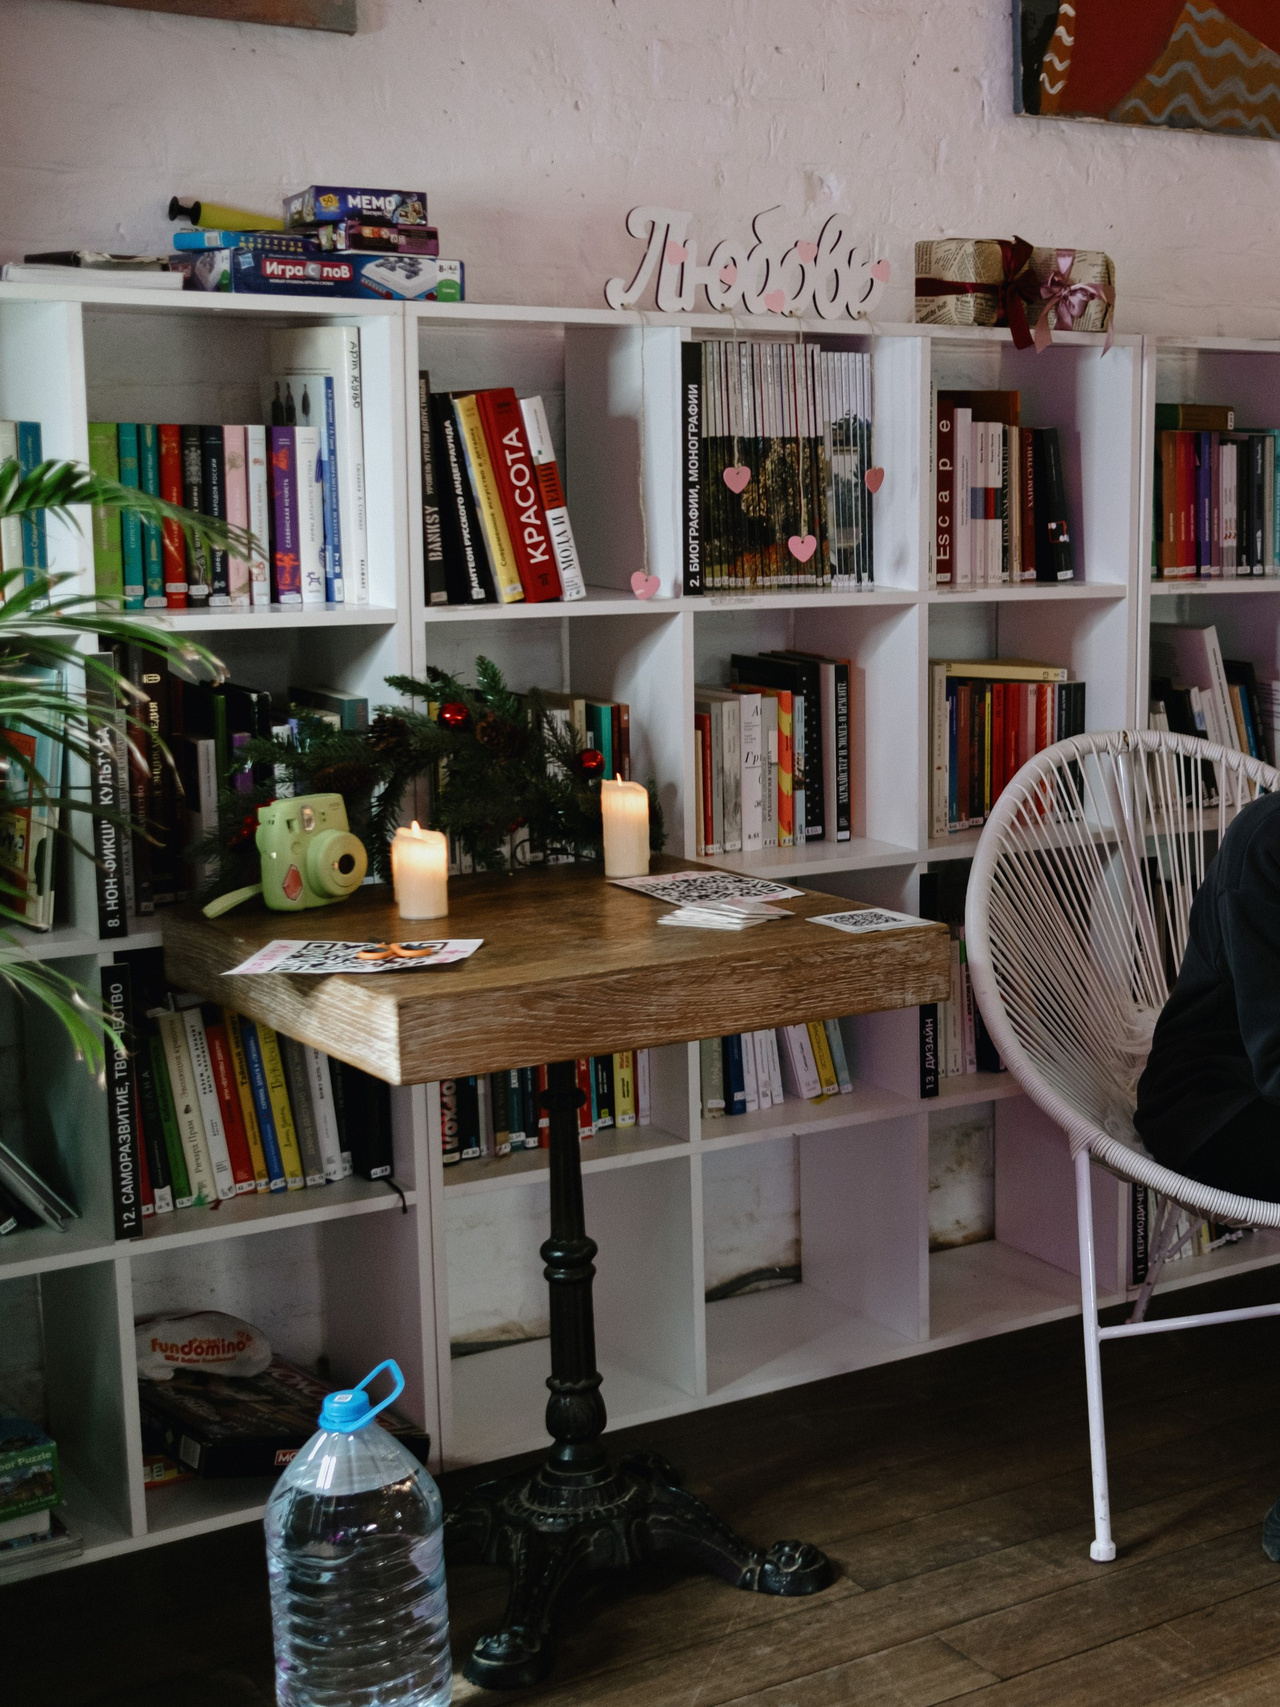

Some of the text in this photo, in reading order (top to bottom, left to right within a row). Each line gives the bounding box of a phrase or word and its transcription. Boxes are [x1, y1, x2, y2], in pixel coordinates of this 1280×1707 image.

[322, 195, 333, 205] 50
[347, 195, 396, 210] МЕМО
[266, 261, 304, 279] Игра
[603, 204, 886, 320] Любовь
[419, 379, 434, 495] УРОВЕНЬ УГРОЗЫ ДОПУСТИМЫЙ
[444, 420, 464, 496] АНДЕГРАУНДА
[502, 427, 549, 564] КРАСОТА
[687, 384, 700, 588] 2. БИОГРАФИИ, МОНОГРАФИИ
[936, 419, 953, 560] Escape
[425, 505, 443, 561] BANKSY
[456, 496, 471, 546] РУССКОГО
[551, 515, 565, 526] И
[556, 529, 576, 571] МОДА
[101, 820, 119, 911] НОН-ФИКШ
[107, 914, 120, 928] 8.
[235, 1051, 248, 1086] Тайный
[925, 1018, 935, 1089] 13. ДИЗАЙН
[115, 1082, 136, 1206] САМОРАЗВИТИЕ,
[187, 1119, 198, 1142] Прам
[191, 1143, 203, 1173] Ричард
[122, 1208, 136, 1228] 12.
[1136, 1184, 1146, 1257] ПЕРИОДИЧЕС
[151, 1338, 246, 1356] fundomino
[18, 1452, 52, 1466] Puzzle
